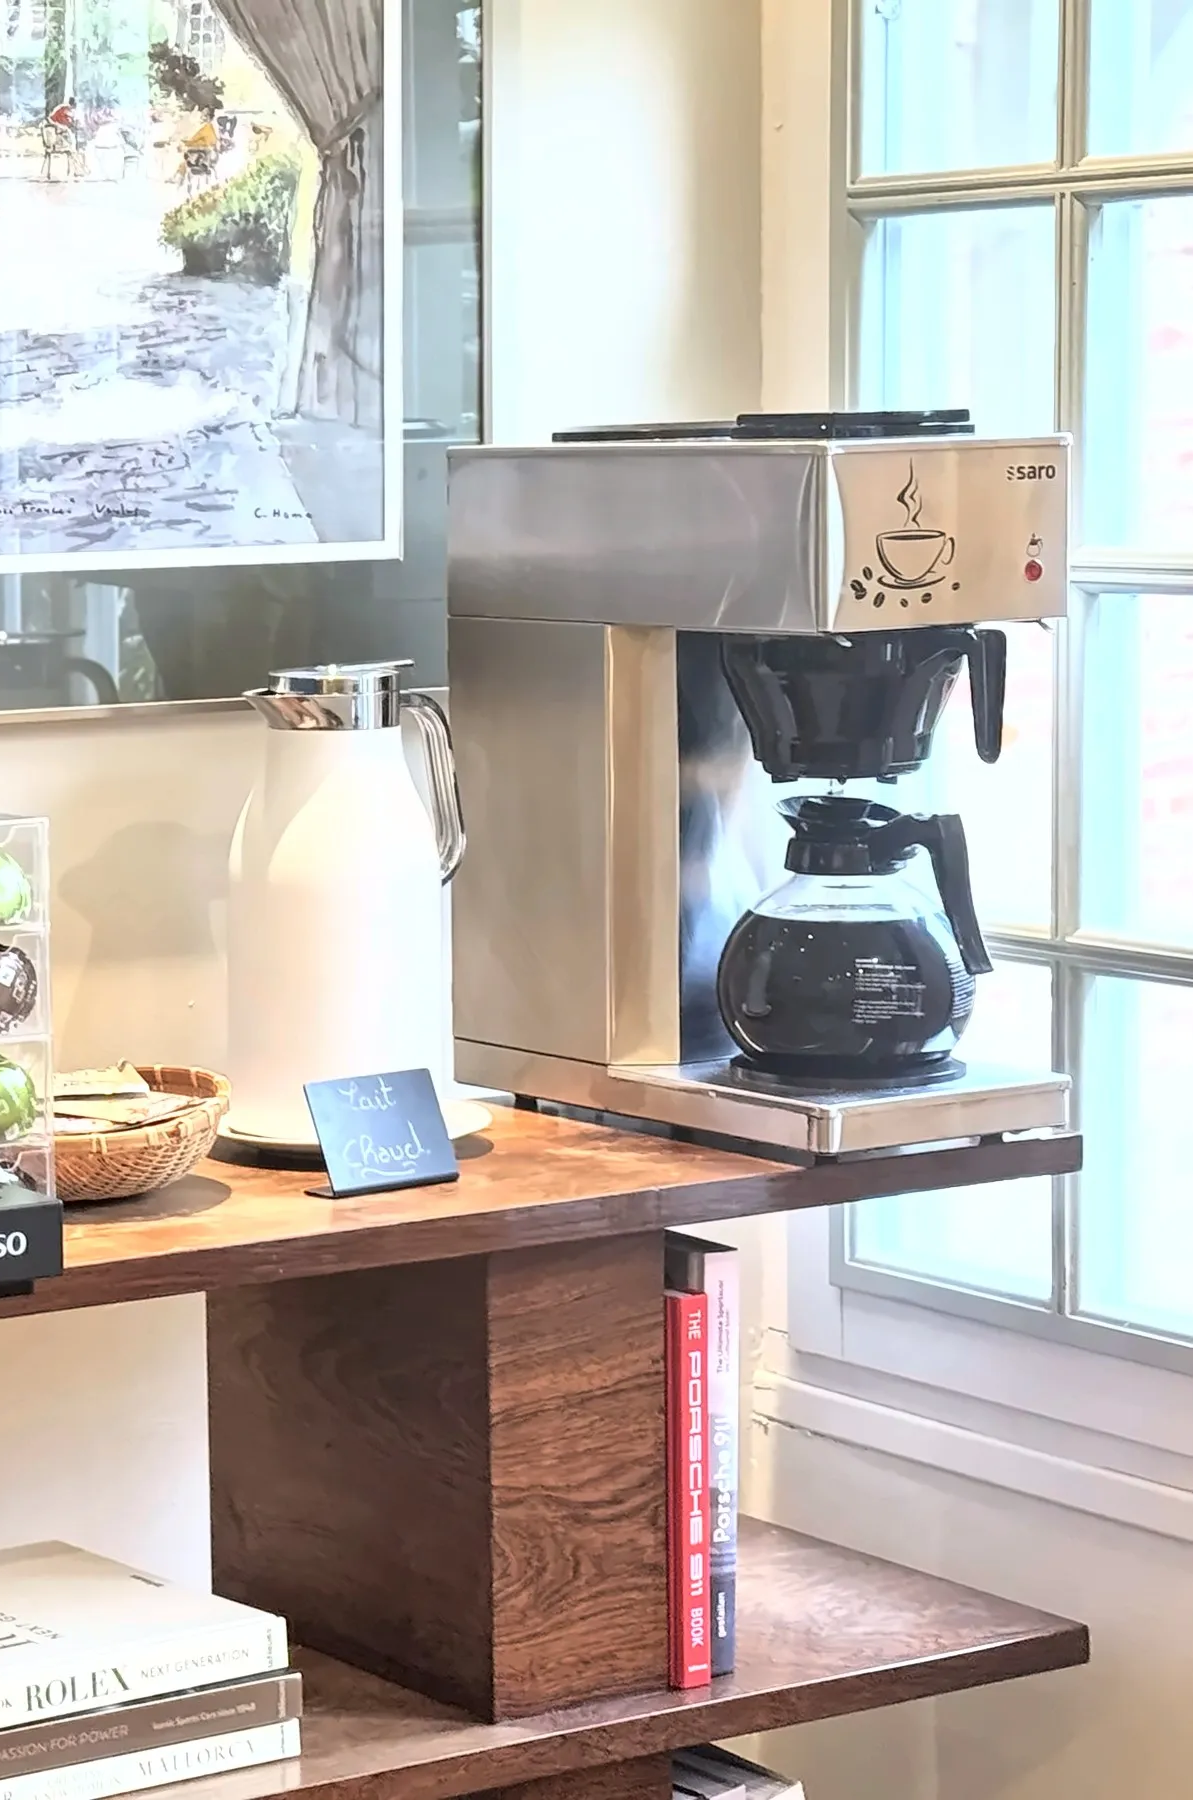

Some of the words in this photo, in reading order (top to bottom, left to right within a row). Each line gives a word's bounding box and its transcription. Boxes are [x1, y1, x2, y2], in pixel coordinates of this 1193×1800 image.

[1016, 465, 1056, 480] saro
[688, 1310, 701, 1340] THE
[688, 1351, 703, 1545] PORSCHE
[713, 1416, 732, 1447] 911
[712, 1449, 731, 1543] Porsche
[690, 1552, 704, 1597] 911
[15, 1622, 64, 1640] NEXT
[690, 1607, 704, 1648] BOOK
[25, 1666, 130, 1712] ROLEX
[141, 1661, 171, 1679] NEXT
[175, 1648, 250, 1674] GENERATION
[50, 1734, 78, 1750] FOR
[79, 1724, 130, 1744] POWER
